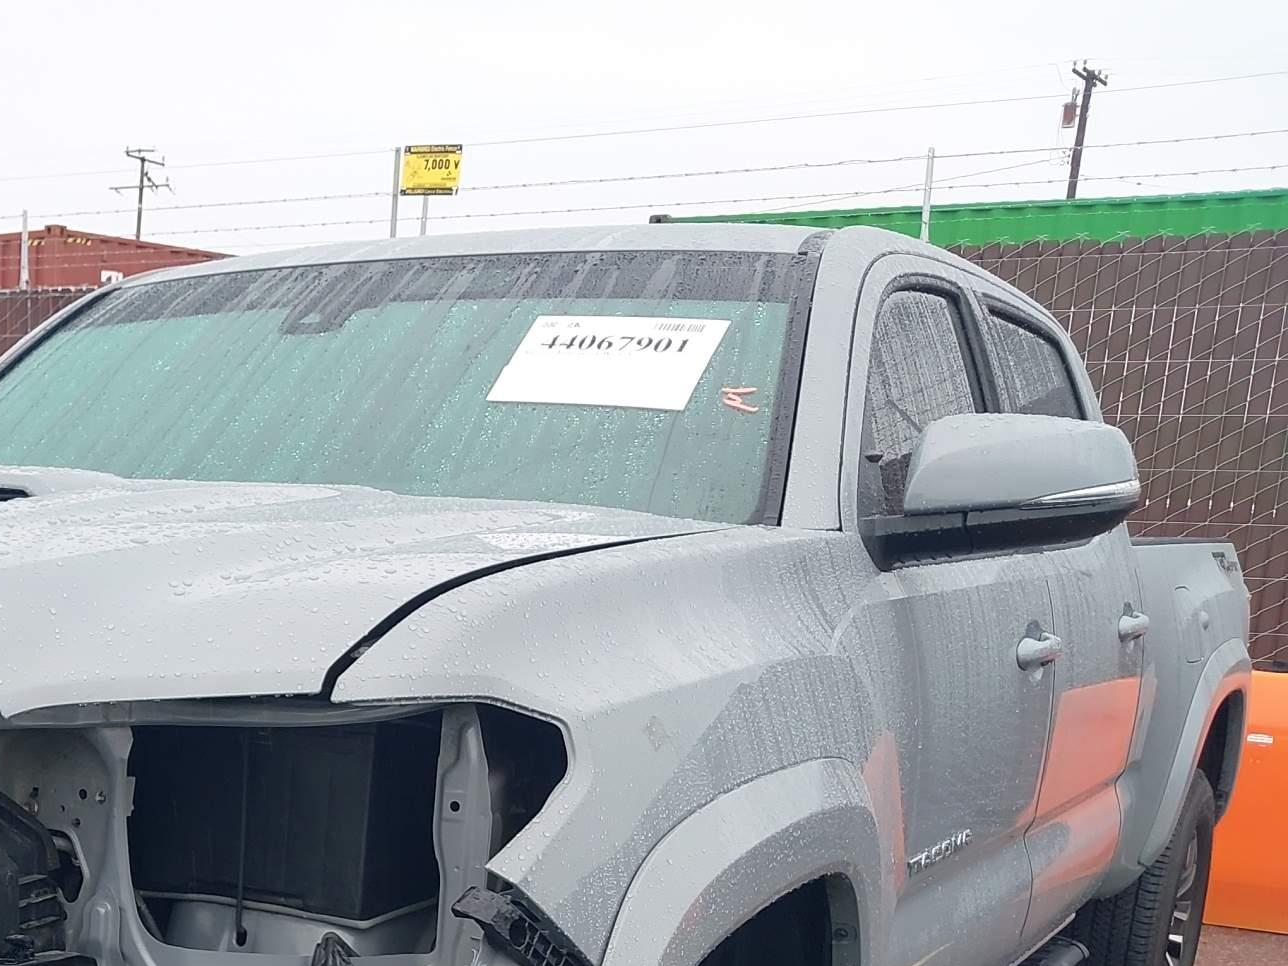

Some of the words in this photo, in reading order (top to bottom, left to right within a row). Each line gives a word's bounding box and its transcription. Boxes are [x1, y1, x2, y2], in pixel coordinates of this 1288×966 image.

[423, 159, 451, 171] 7,000
[454, 160, 461, 170] V
[540, 334, 690, 353] 44067901
